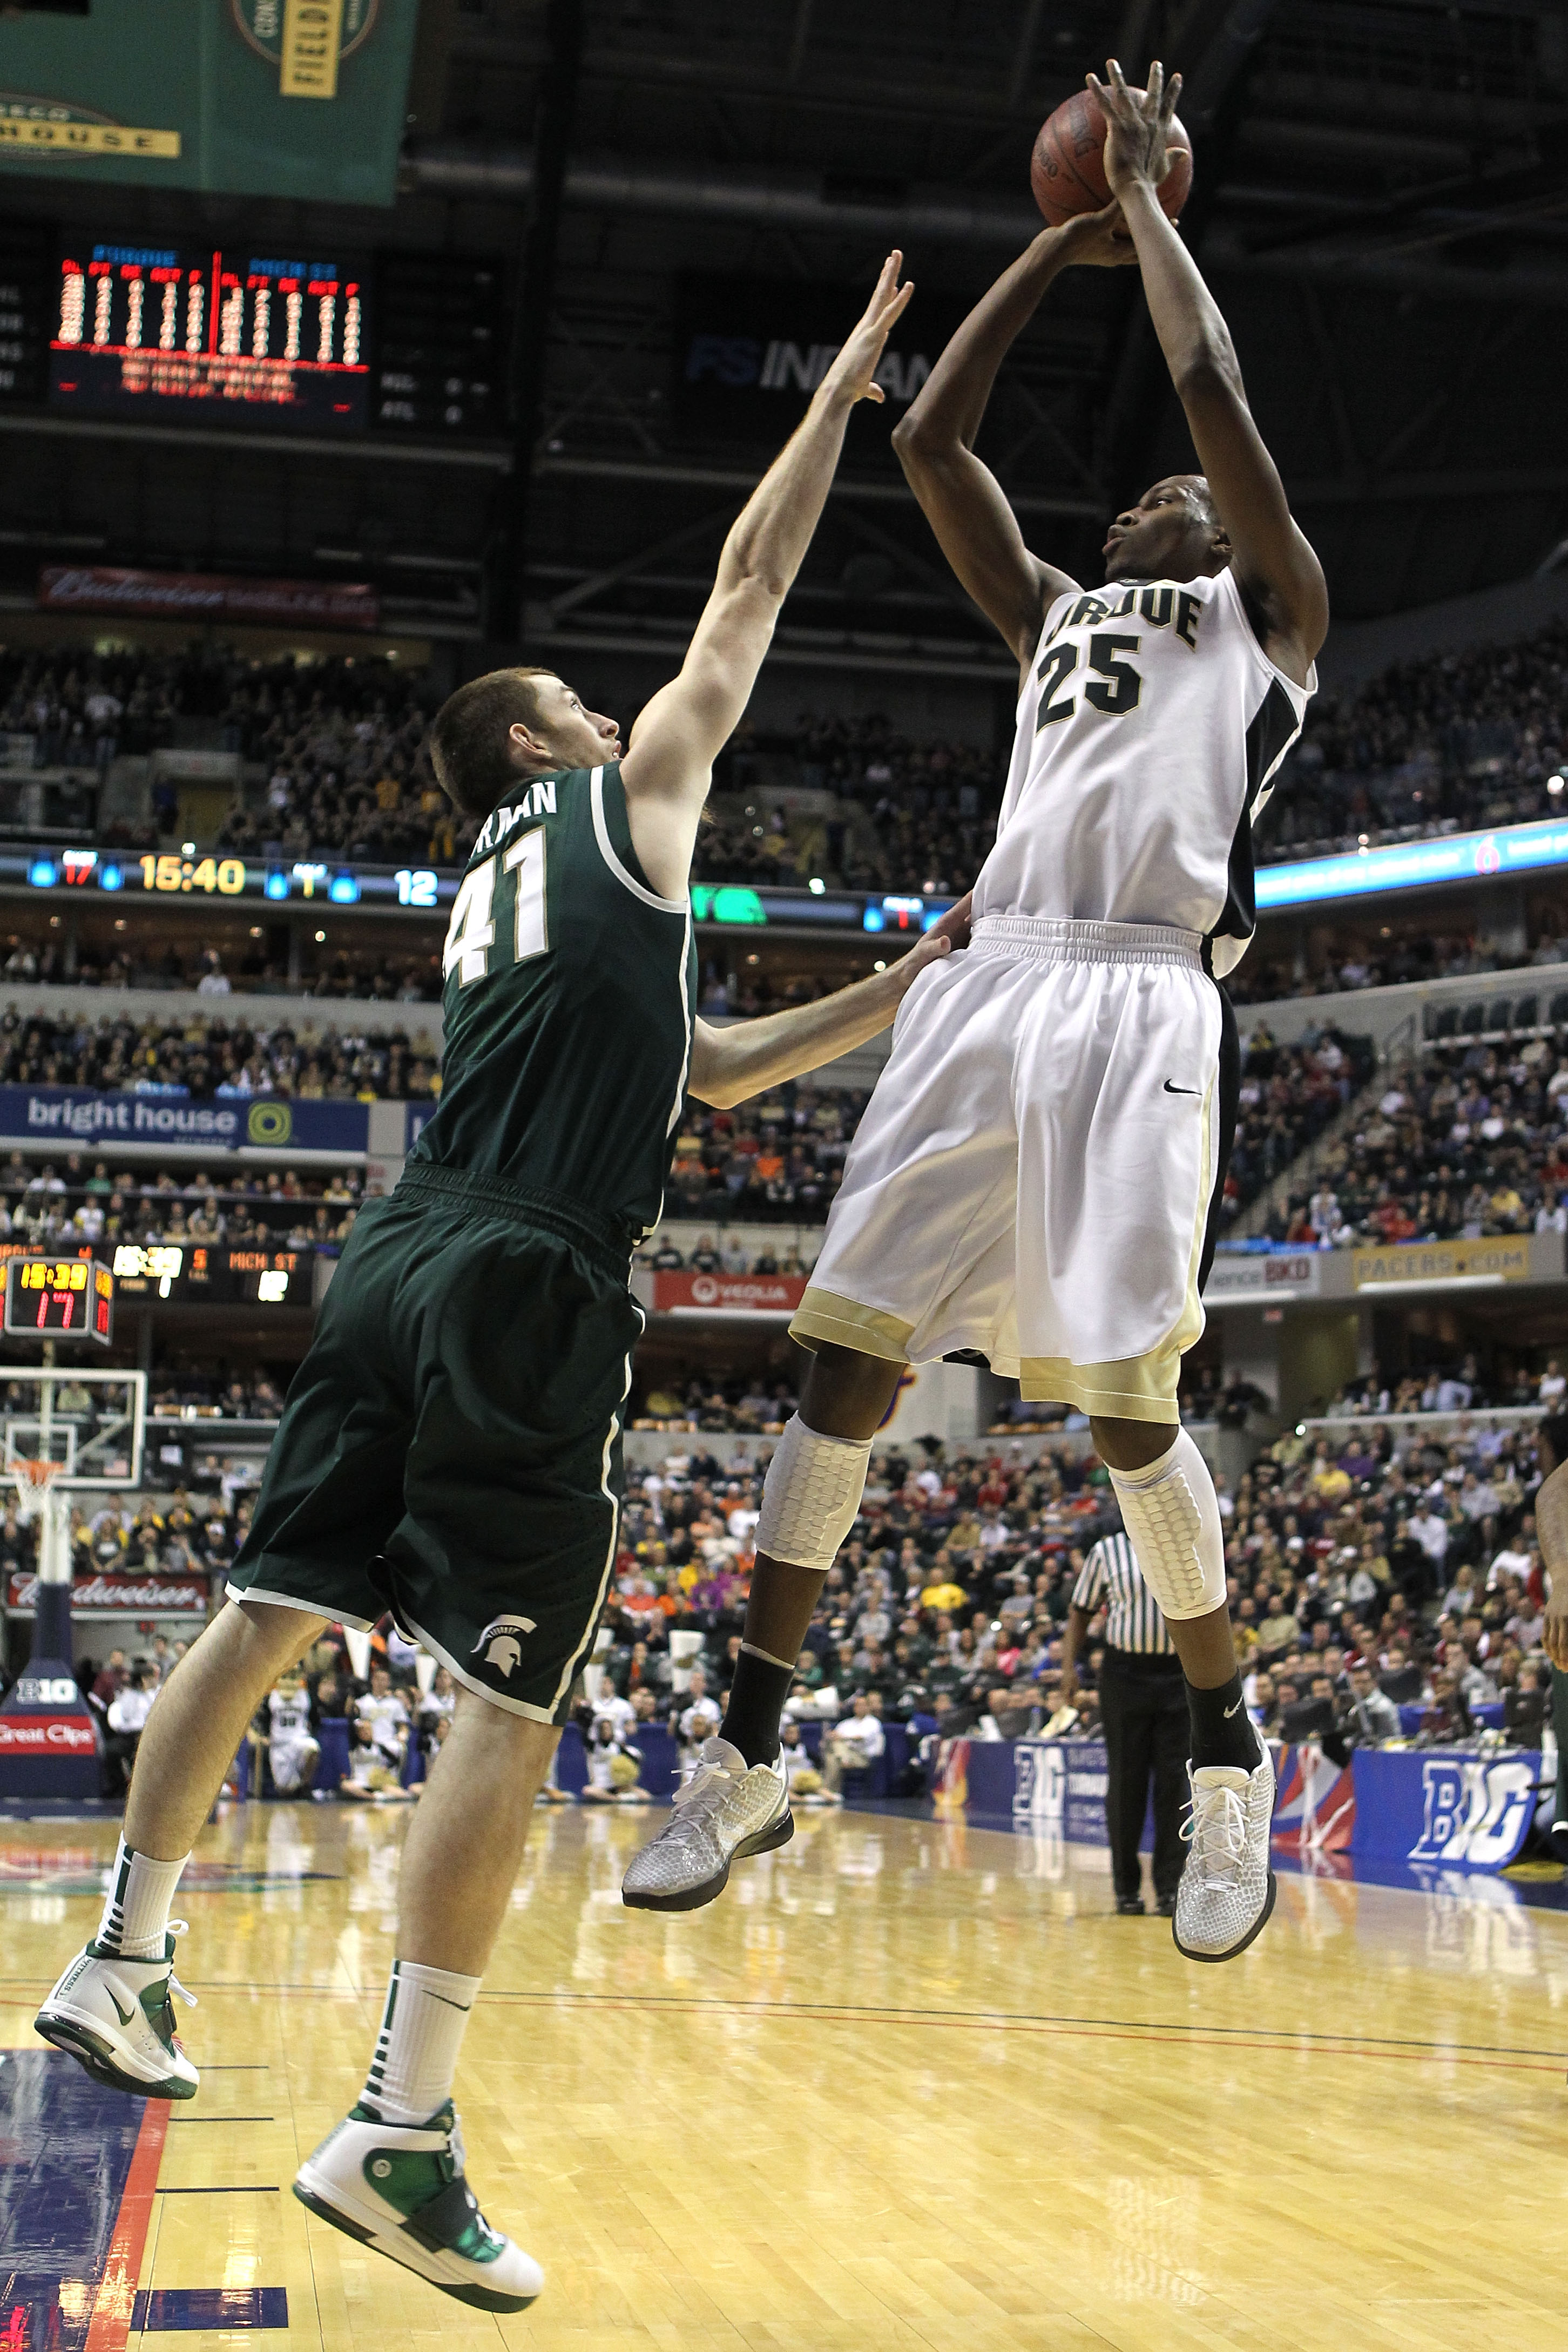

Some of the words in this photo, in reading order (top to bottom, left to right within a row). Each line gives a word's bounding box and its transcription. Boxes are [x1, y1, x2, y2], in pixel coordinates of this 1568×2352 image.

[1035, 632, 1143, 738] 25
[140, 855, 245, 894] 15:40
[394, 870, 438, 907] 12
[443, 824, 549, 989] 41
[28, 1097, 129, 1133] bright
[134, 1101, 239, 1132] house
[21, 1262, 88, 1290] 15:39
[229, 1252, 268, 1270] MICH
[274, 1253, 297, 1270] ST
[1358, 1250, 1524, 1279] PACERS.COM
[37, 1291, 75, 1329] 17
[10, 1572, 205, 1611] Bdweiser
[0, 1725, 47, 1745] Great
[47, 1724, 94, 1747] Clips
